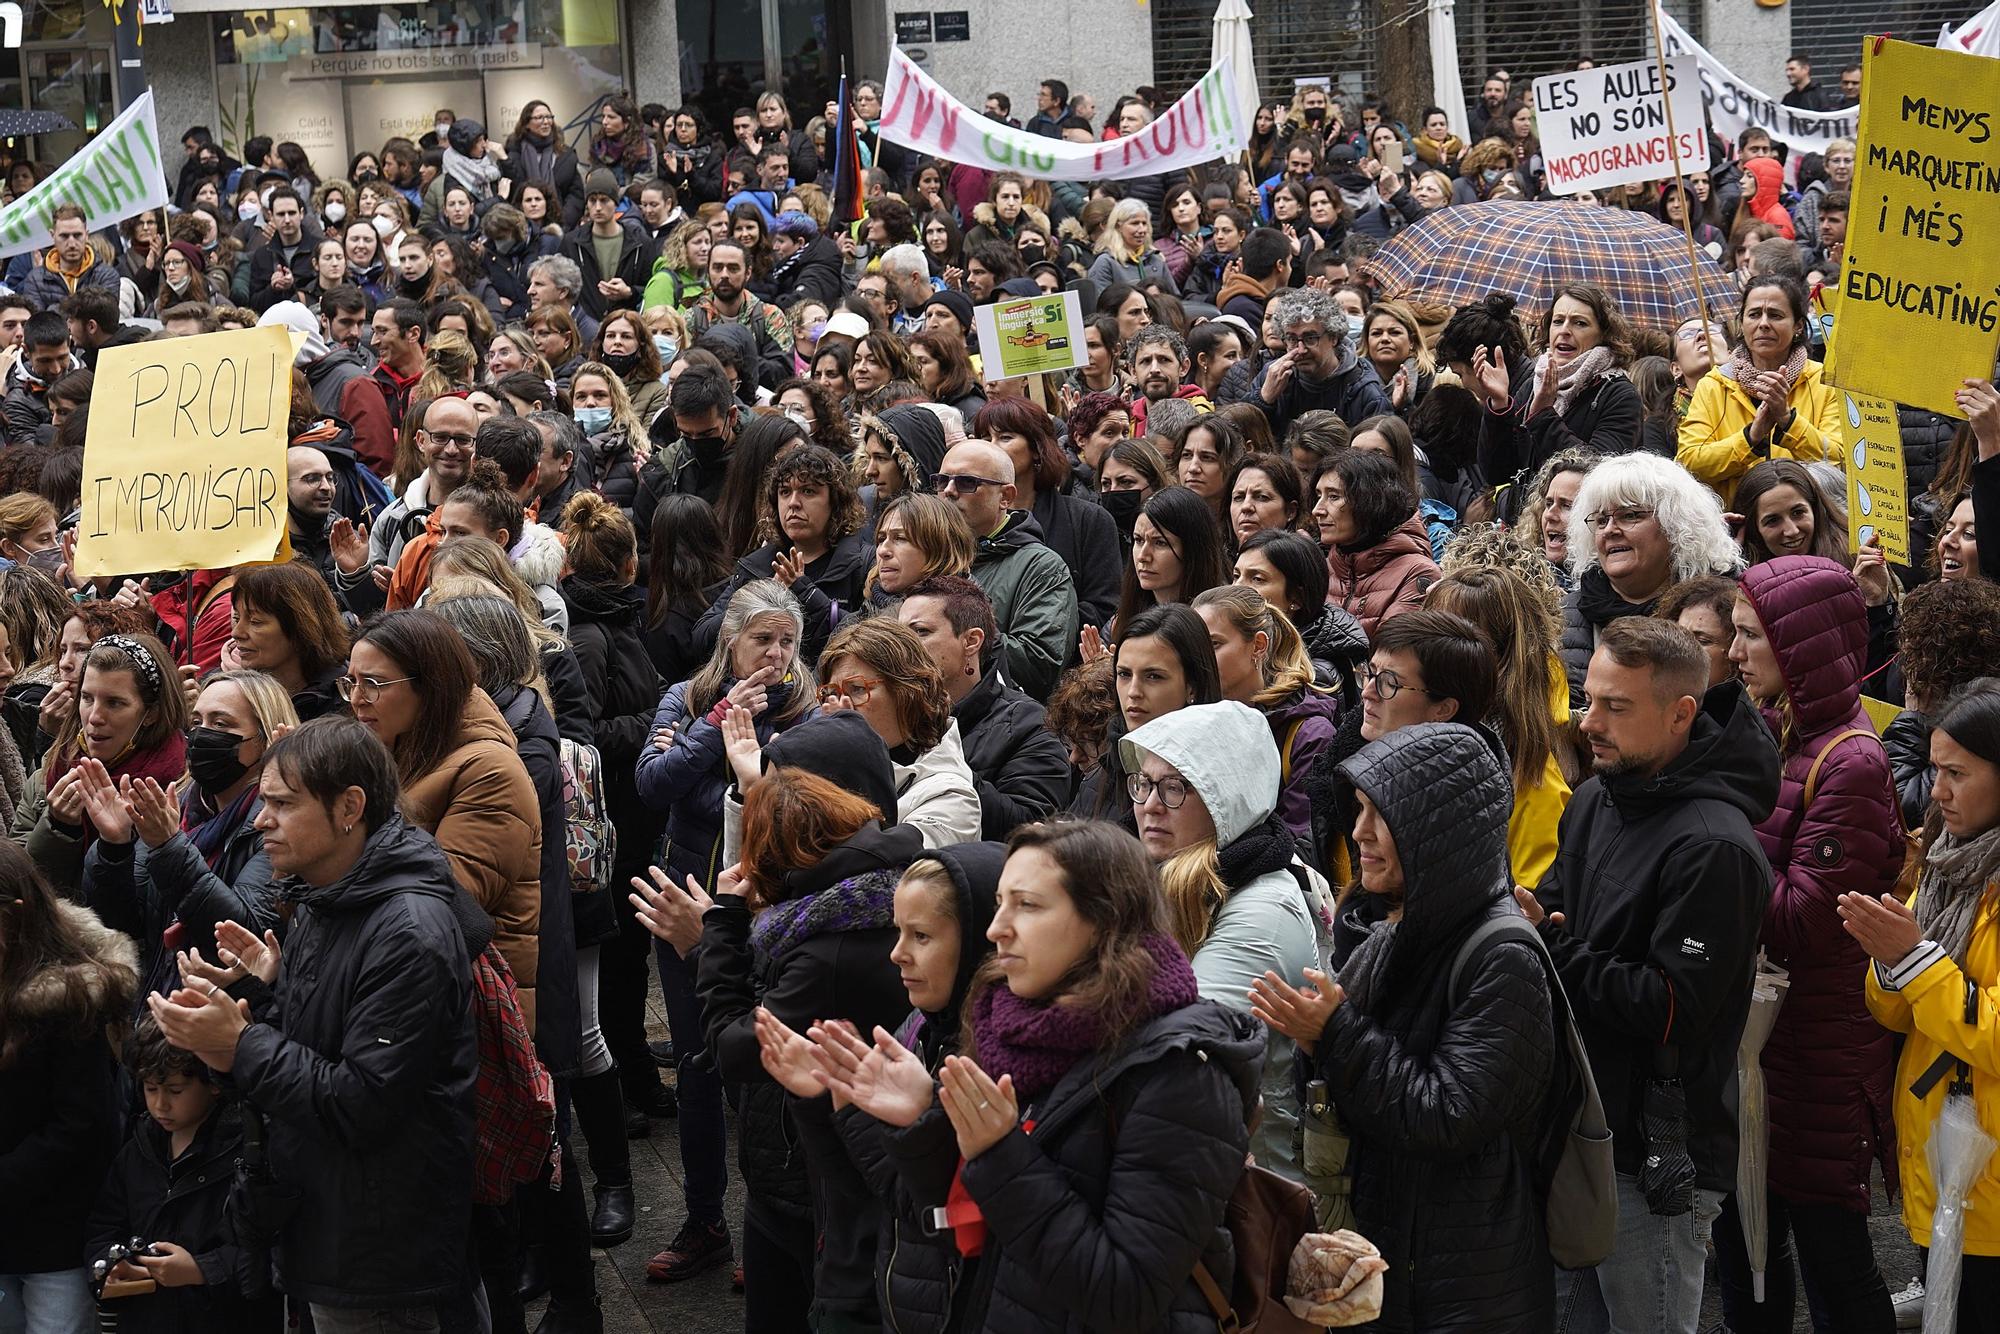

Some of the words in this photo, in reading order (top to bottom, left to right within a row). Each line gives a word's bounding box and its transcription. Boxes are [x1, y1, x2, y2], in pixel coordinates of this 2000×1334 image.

[311, 56, 368, 74] Perquè
[372, 58, 392, 71] no
[397, 54, 427, 69] tots
[432, 53, 467, 66] som
[472, 48, 520, 68] iguals
[1537, 79, 1578, 112] LES
[1604, 64, 1676, 103] AULES
[276, 127, 334, 141] sostenible
[298, 115, 326, 128] Càlid
[380, 118, 403, 129] Estil
[1571, 112, 1600, 140] NO
[1613, 98, 1664, 132] SÓN
[1787, 109, 1850, 139] hem
[1902, 95, 1990, 143] MENYS
[1902, 201, 1963, 247] MÉS
[998, 306, 1044, 321] Immersió
[1044, 303, 1063, 324] Sí
[129, 352, 276, 439] PROU
[90, 464, 277, 538] IMPROVISAR
[1890, 488, 1900, 498] DEL
